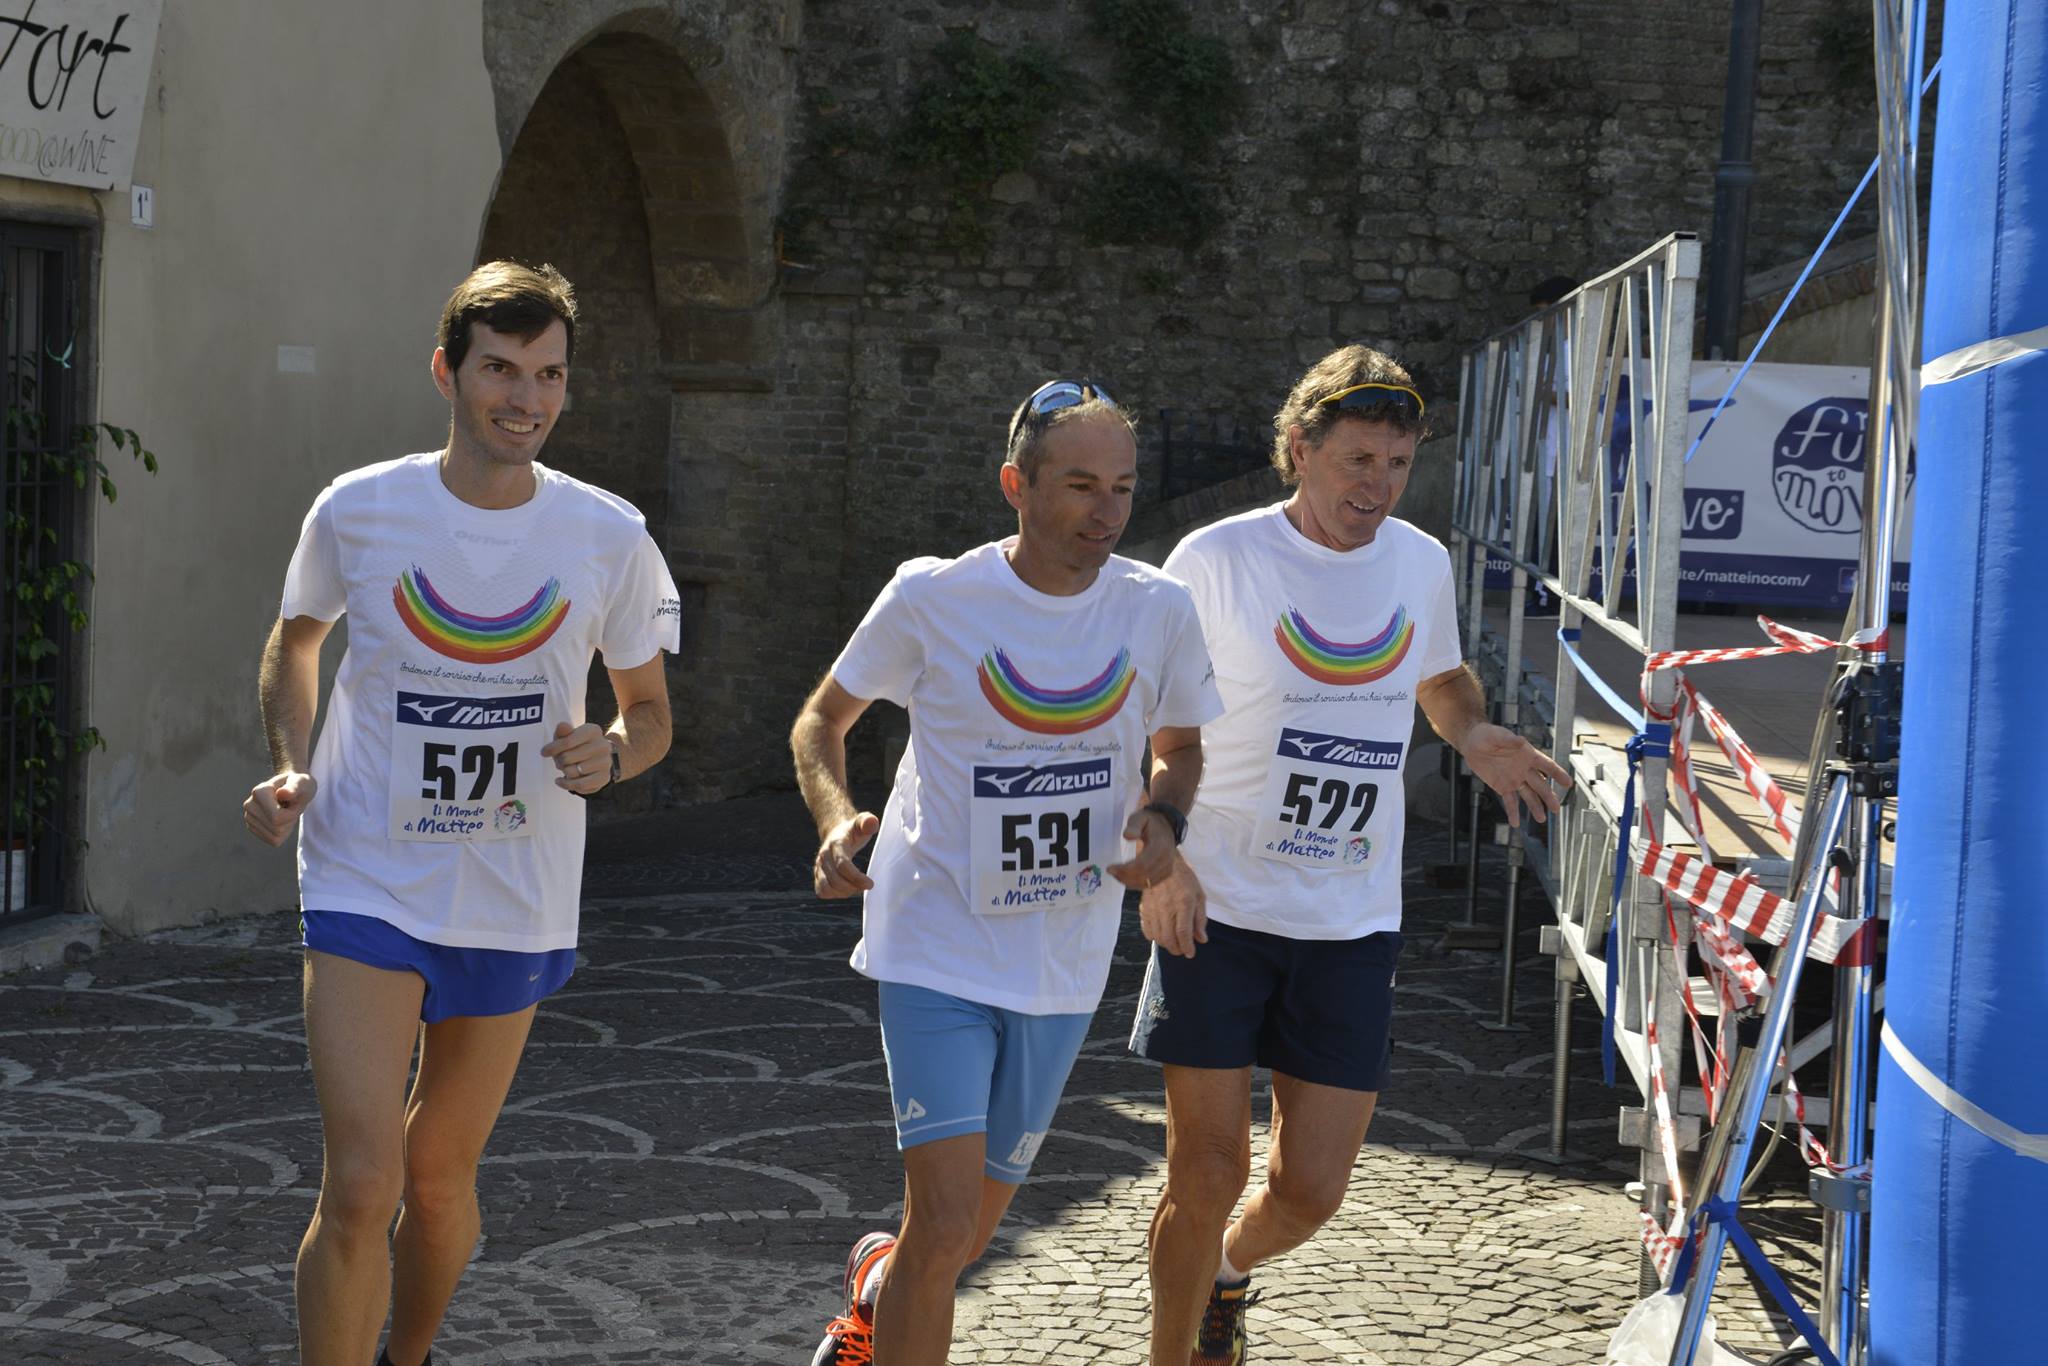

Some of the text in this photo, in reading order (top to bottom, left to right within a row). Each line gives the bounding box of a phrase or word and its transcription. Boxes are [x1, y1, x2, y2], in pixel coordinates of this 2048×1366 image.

[0, 124, 115, 176] OOD@WINE
[1827, 469, 1846, 482] to
[422, 742, 519, 800] 521
[446, 805, 484, 817] Mondo
[1279, 773, 1379, 832] 522
[404, 817, 484, 834] di Matteo
[1002, 807, 1090, 871] 531
[1305, 830, 1338, 845] Mondo
[1266, 839, 1335, 859] di Matteo
[1030, 873, 1067, 886] Mondo
[991, 896, 1001, 906] di
[1004, 887, 1066, 906] Matteo
